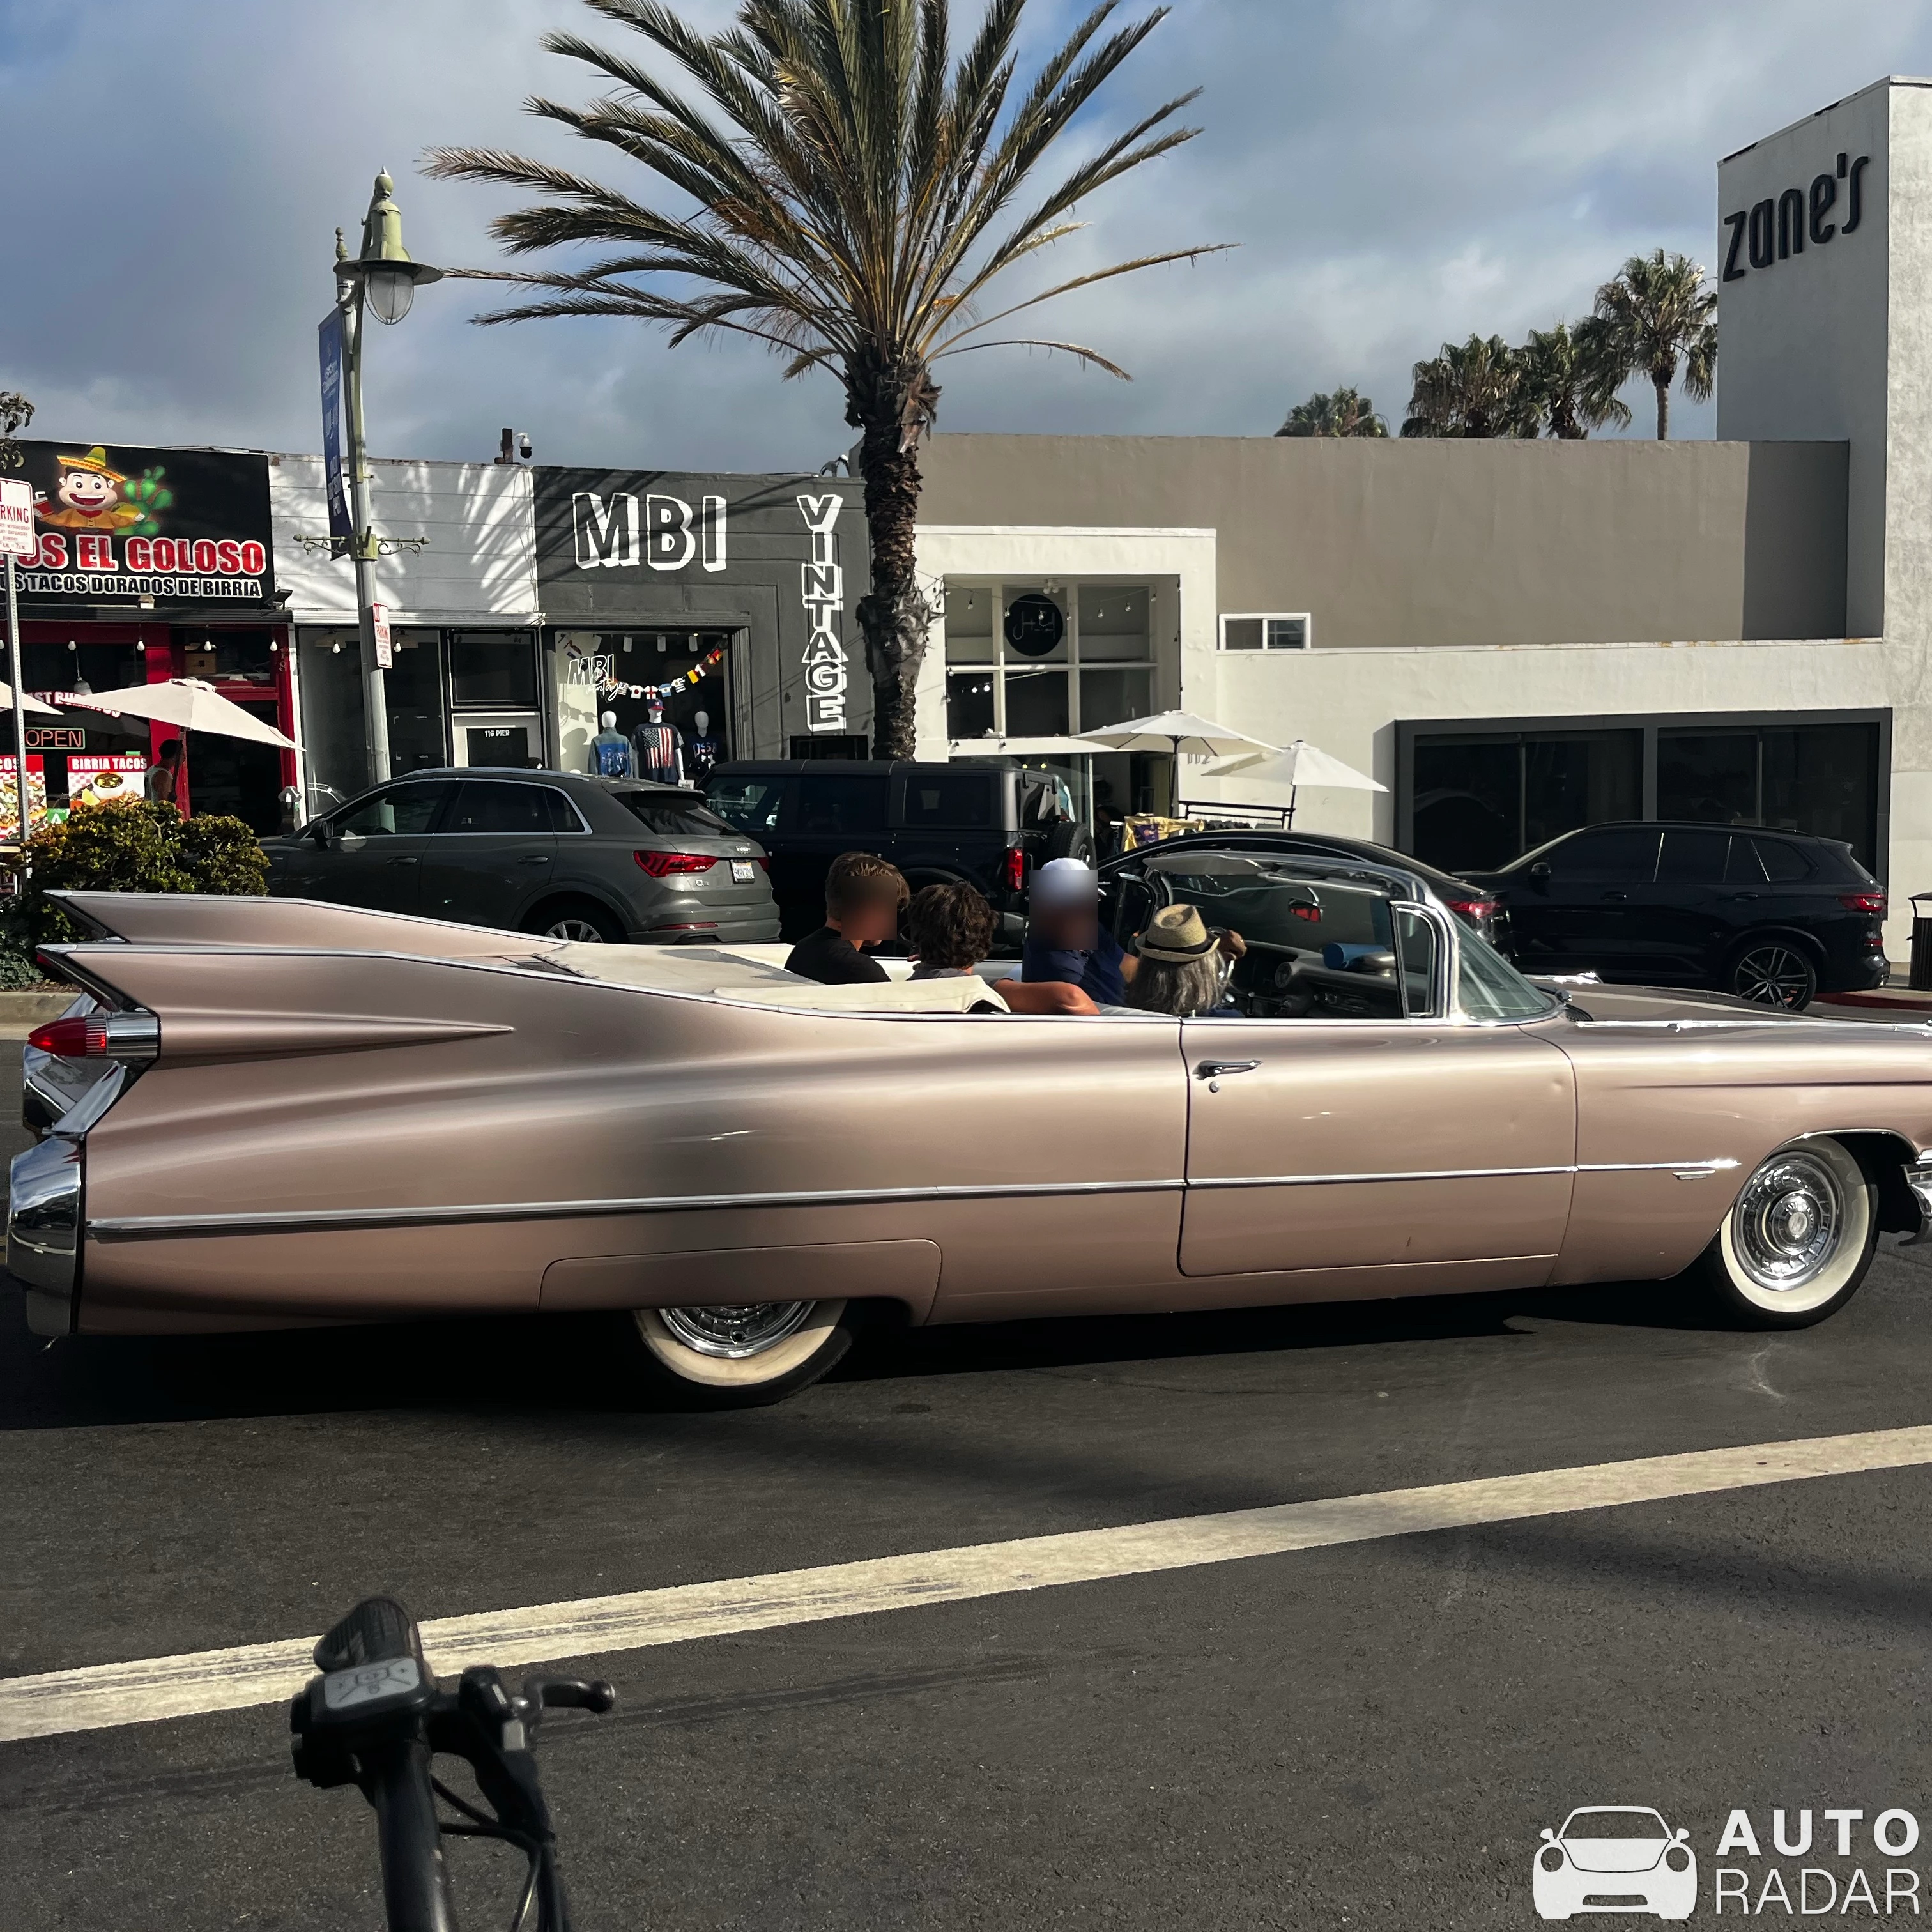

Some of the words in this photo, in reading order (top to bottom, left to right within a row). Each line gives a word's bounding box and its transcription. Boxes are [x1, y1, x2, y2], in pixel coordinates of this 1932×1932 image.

[1723, 153, 1870, 282] zane's
[572, 492, 727, 572] MBI
[75, 534, 119, 571] EL
[126, 537, 266, 575] GOLOSO
[27, 574, 89, 593] TACOS
[91, 575, 174, 595] DORADOS
[178, 578, 200, 595] DE
[202, 578, 261, 597] BIRRIA
[796, 494, 848, 732] VINTAGE
[567, 654, 614, 685] MBI
[26, 730, 82, 747] OPEN
[72, 758, 110, 770] BIRRIA
[112, 757, 147, 770] TACOS
[51, 813, 61, 824] A
